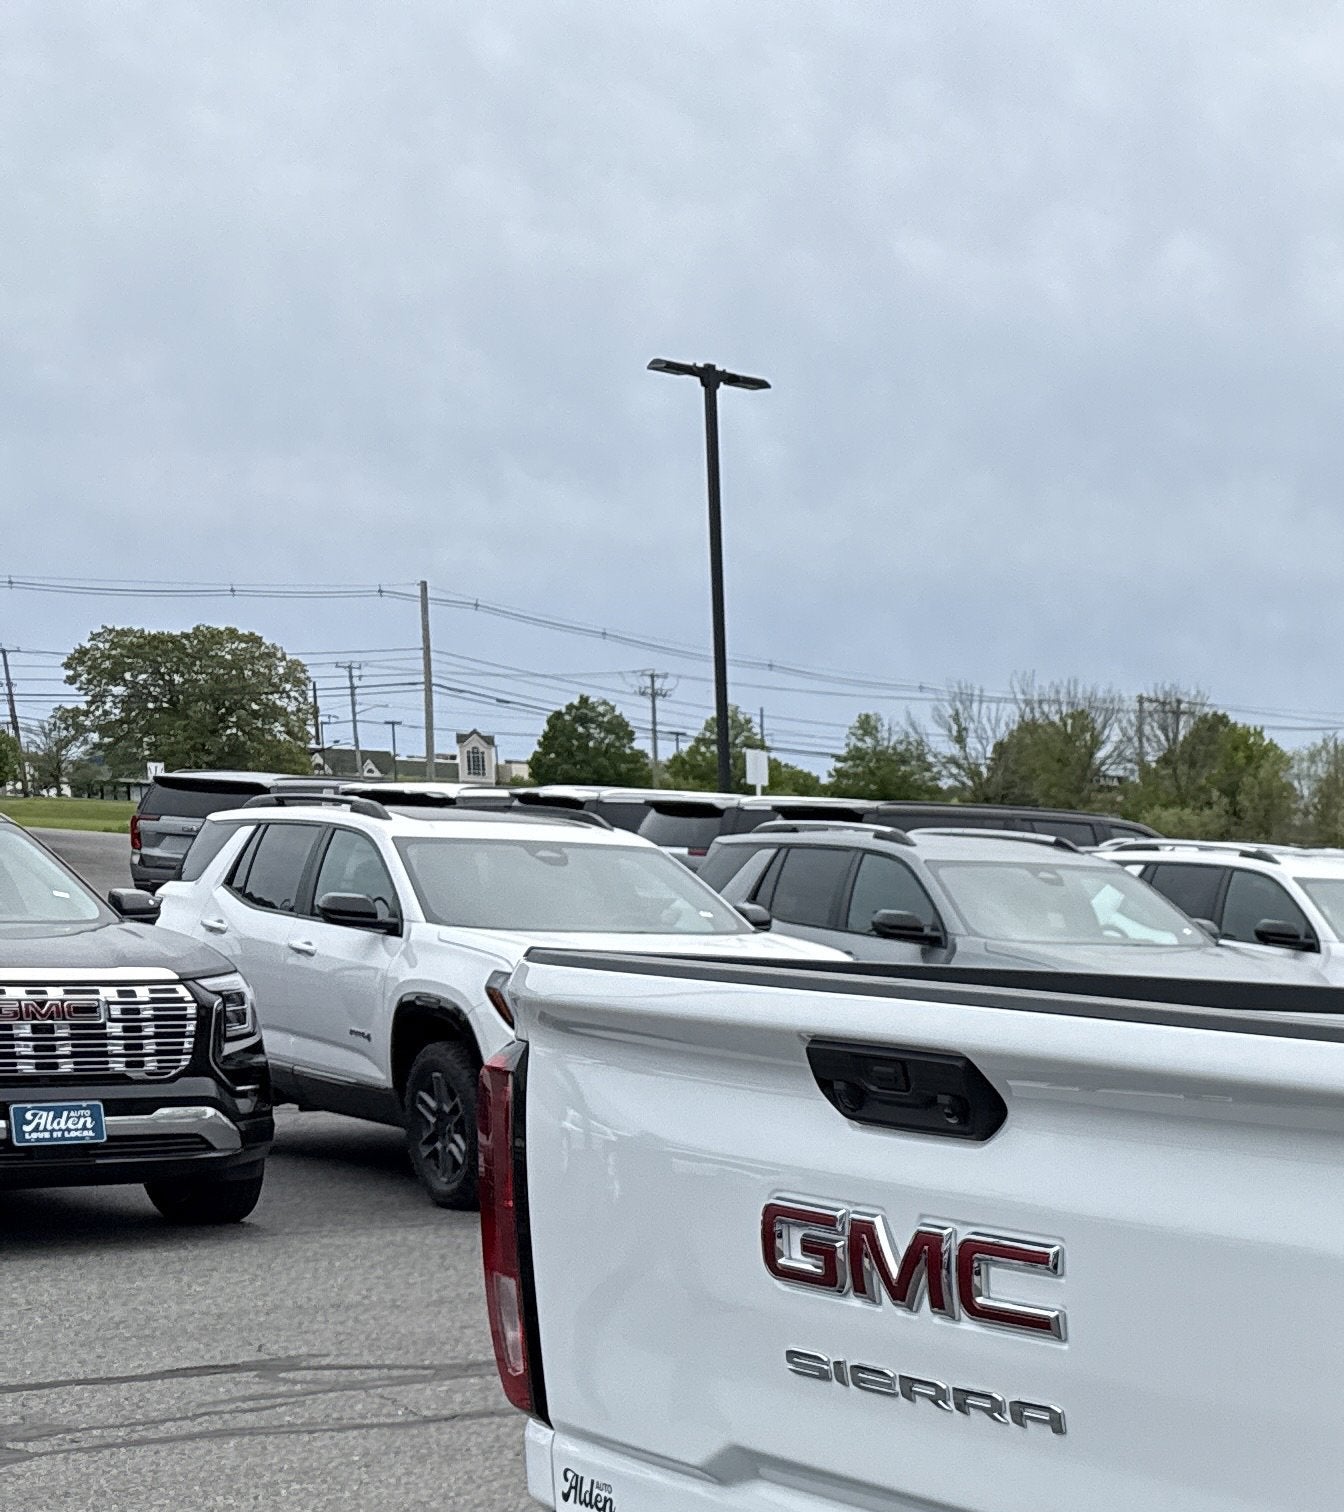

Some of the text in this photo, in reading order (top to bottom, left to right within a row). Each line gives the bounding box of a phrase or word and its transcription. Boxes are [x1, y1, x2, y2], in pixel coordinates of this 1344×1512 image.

[0, 1000, 99, 1021] GMC
[22, 1109, 95, 1132] Alden
[69, 1109, 91, 1117] AUTO
[25, 1129, 95, 1139] LOVE IT LOCAL
[761, 1194, 1068, 1342] GMC
[785, 1347, 1067, 1435] SIERRA
[595, 1480, 613, 1495] AUTO
